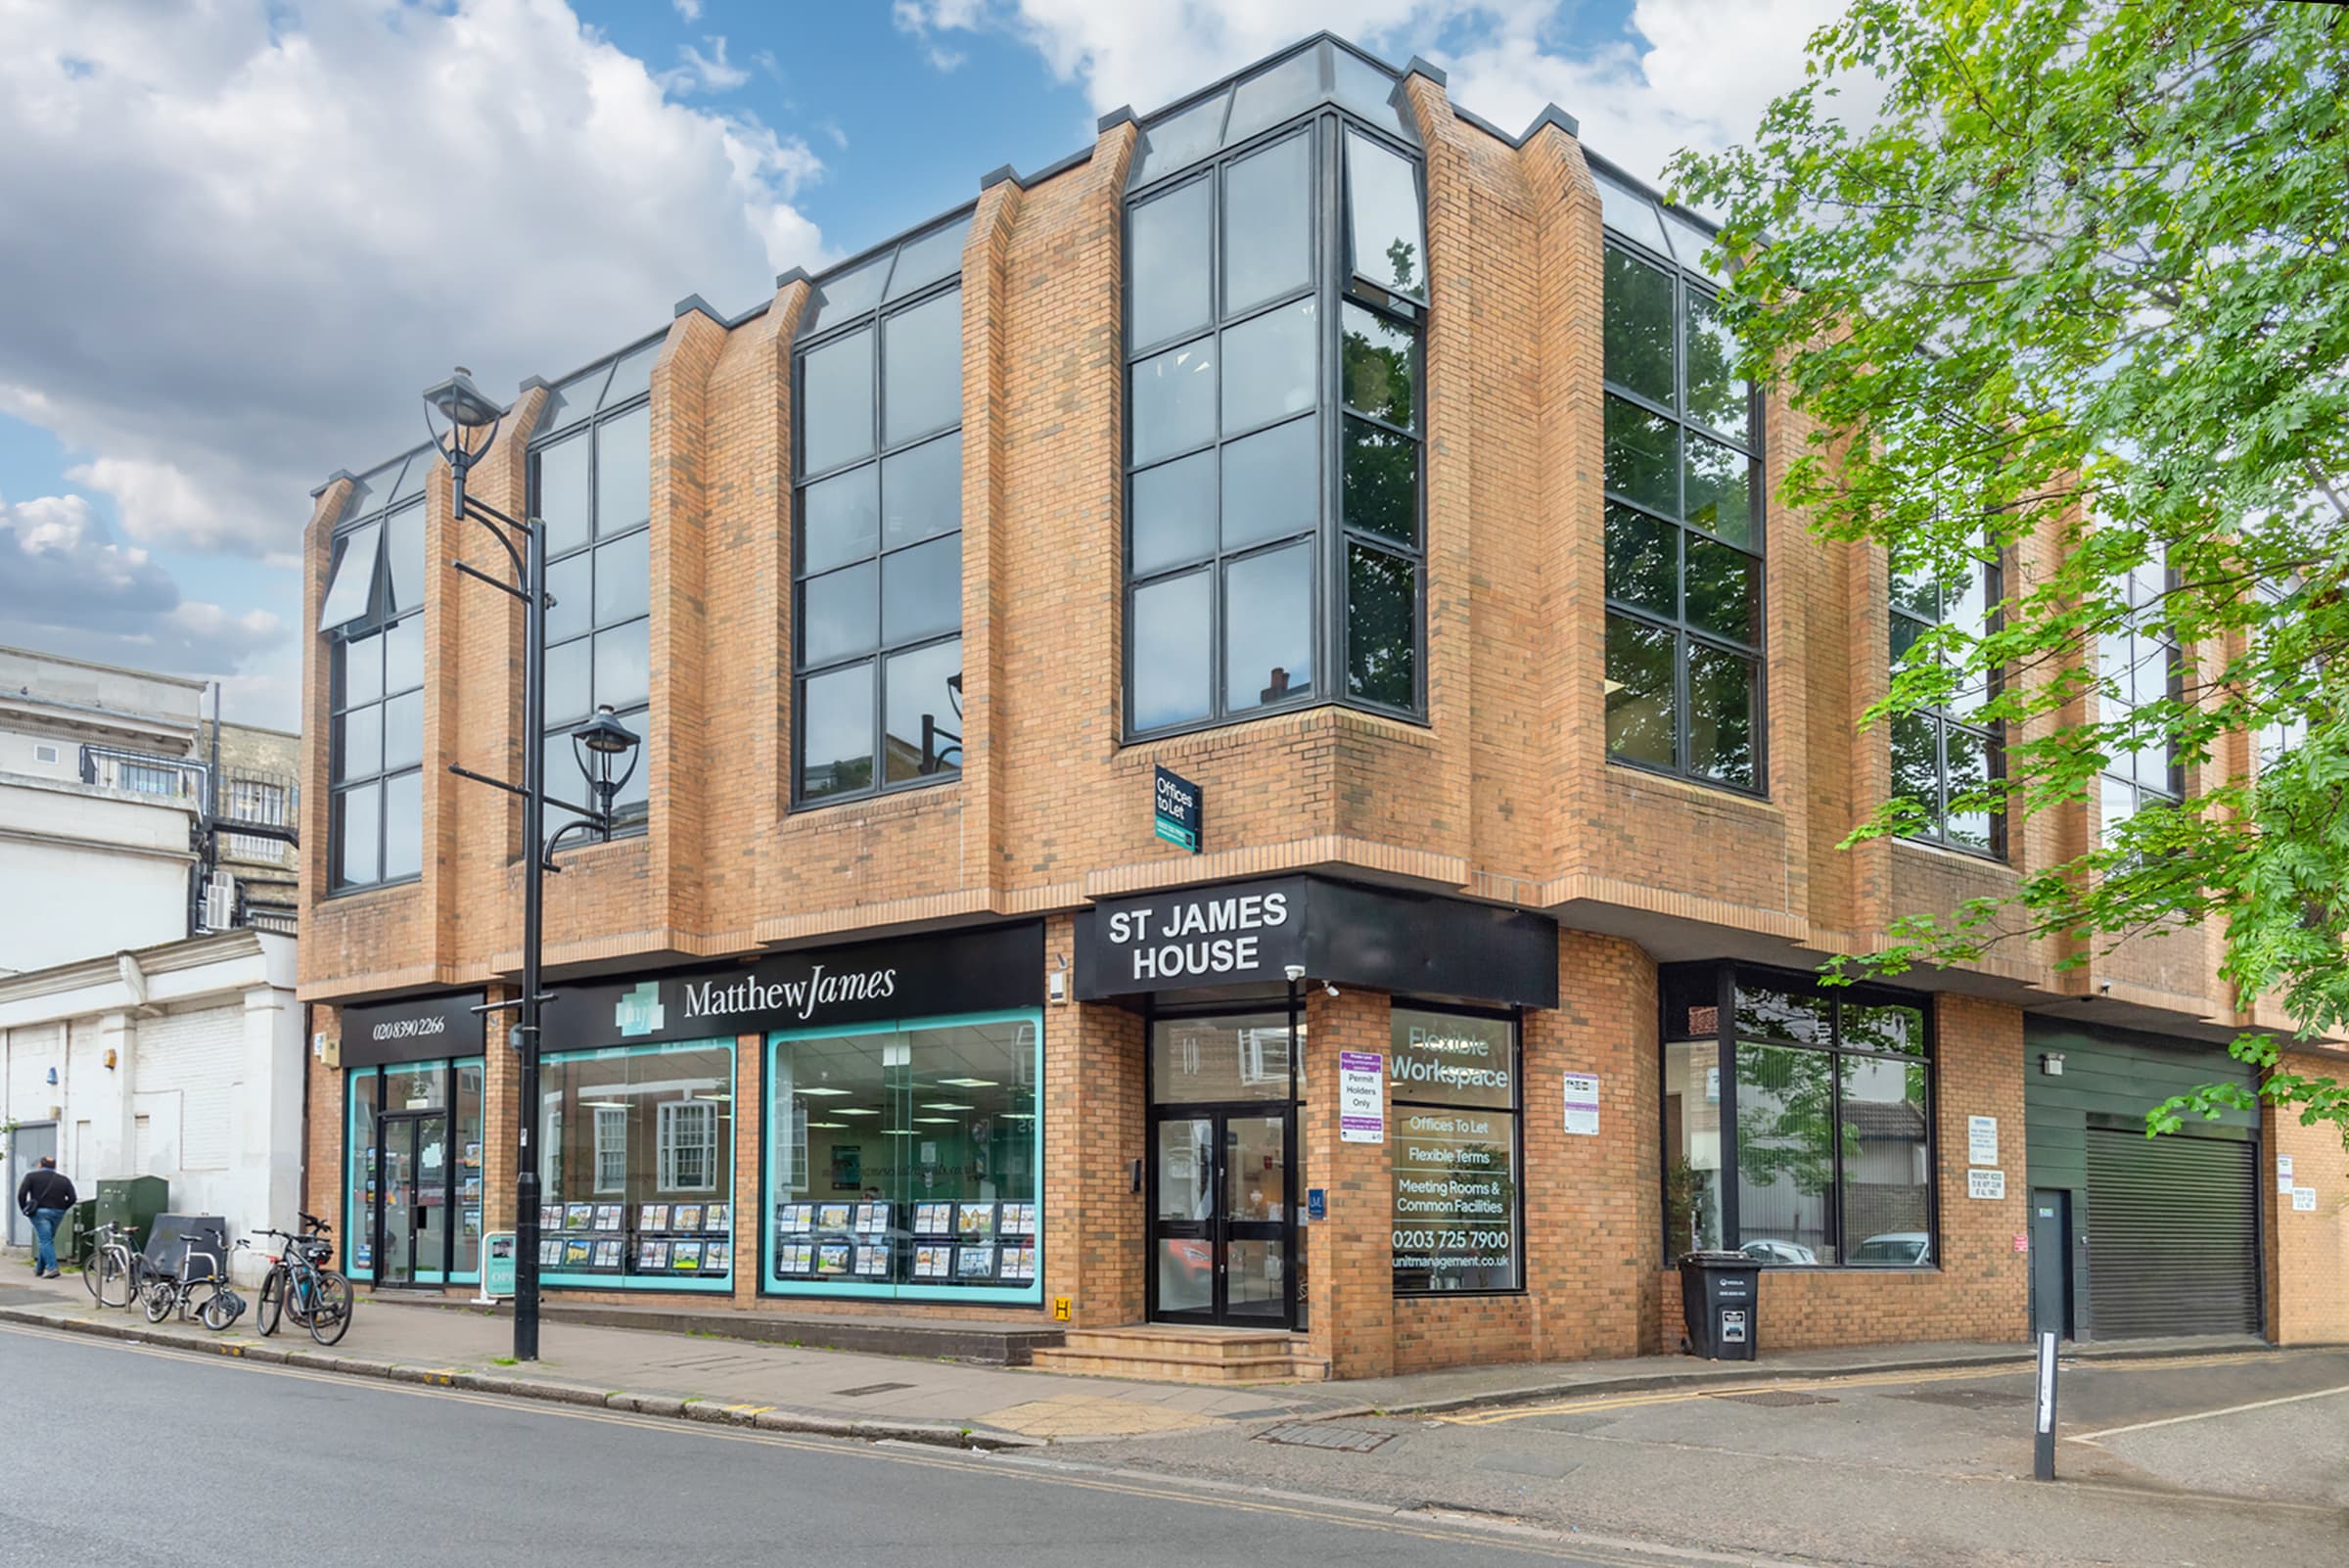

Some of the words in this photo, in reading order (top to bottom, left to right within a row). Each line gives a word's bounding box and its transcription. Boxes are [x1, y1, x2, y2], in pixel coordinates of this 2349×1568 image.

[1157, 777, 1193, 808] Offices
[1158, 794, 1169, 811] to
[1169, 798, 1185, 820] Let
[1109, 908, 1153, 945] ST
[1162, 892, 1289, 939] JAMES
[1133, 936, 1260, 980] HOUSE
[373, 1023, 392, 1040] 020
[392, 1020, 418, 1038] 8390
[418, 1016, 445, 1036] 2266
[1408, 1026, 1489, 1056] Flexible
[1349, 1073, 1374, 1084] Permit
[1391, 1054, 1508, 1090] Workspace
[1347, 1085, 1377, 1096] Holders
[1353, 1098, 1370, 1109] Only
[1410, 1116, 1454, 1132] Offices
[1455, 1118, 1470, 1132] To
[1471, 1120, 1489, 1133] Let
[1409, 1147, 1454, 1163] Flexible
[1455, 1148, 1491, 1165] Terms
[1399, 1179, 1448, 1197] Meeting
[1450, 1180, 1490, 1195] Rooms
[1491, 1181, 1500, 1195] &
[1397, 1197, 1452, 1213] Common
[1454, 1199, 1504, 1214] Facilities
[1392, 1229, 1435, 1248] 0203
[1437, 1230, 1466, 1249] 725
[1469, 1230, 1509, 1249] 7900
